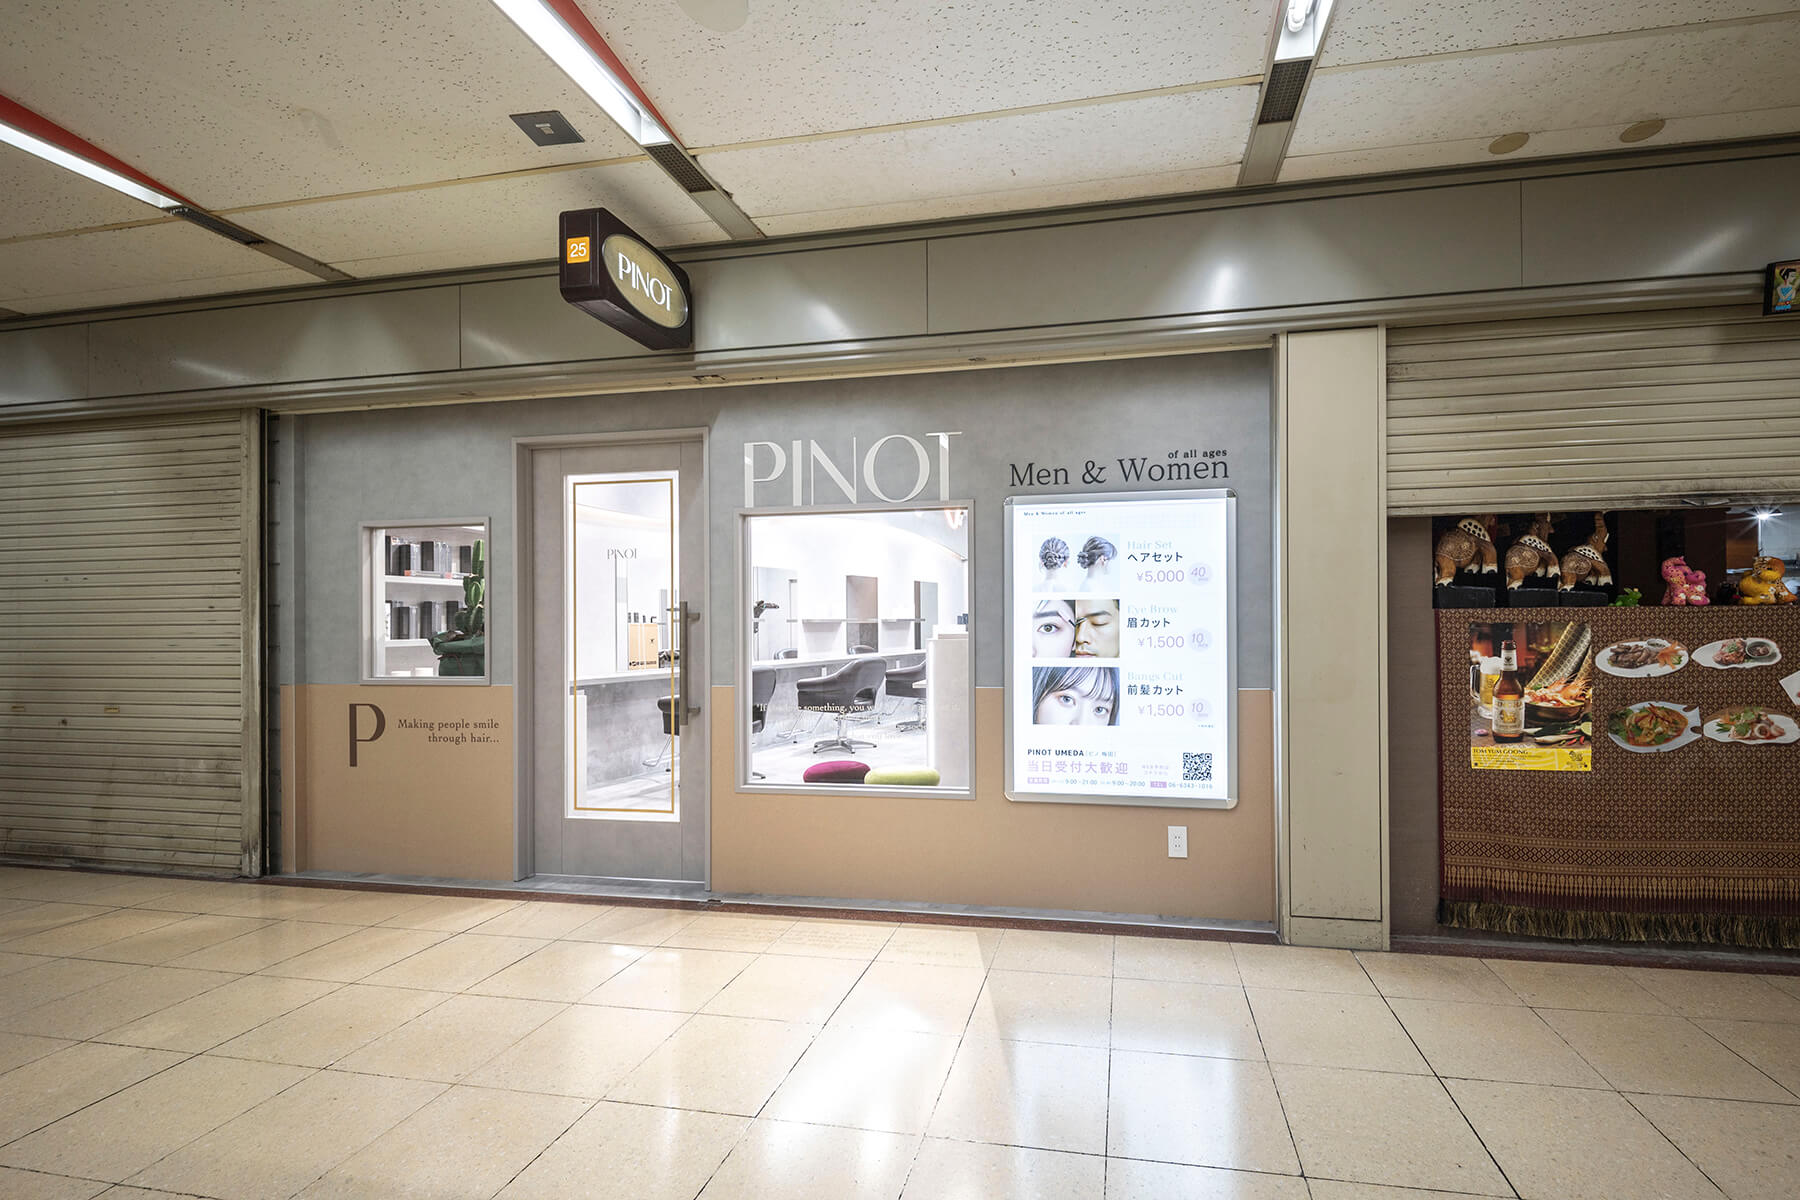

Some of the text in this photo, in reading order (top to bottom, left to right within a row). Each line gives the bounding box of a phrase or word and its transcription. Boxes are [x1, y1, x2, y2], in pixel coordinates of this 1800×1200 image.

[570, 243, 587, 258] 25
[618, 252, 673, 312] PINOT
[1183, 449, 1197, 458] all
[1202, 449, 1228, 459] ages
[744, 431, 963, 508] PINOT
[1009, 457, 1229, 487] Men & Women
[1127, 540, 1172, 550] Hair Set
[1127, 552, 1183, 562] ヘアセット
[1127, 617, 1171, 628] 眉カット
[1127, 684, 1184, 696] 前髪カット
[803, 702, 848, 716] something,
[849, 705, 864, 714] you
[397, 718, 500, 731] Making people smile
[349, 703, 386, 767] P
[428, 733, 500, 746] through hair...
[1027, 748, 1052, 756] PINOT
[1055, 749, 1084, 757] UMEDA
[1028, 760, 1129, 775] 当日受付大歓迎
